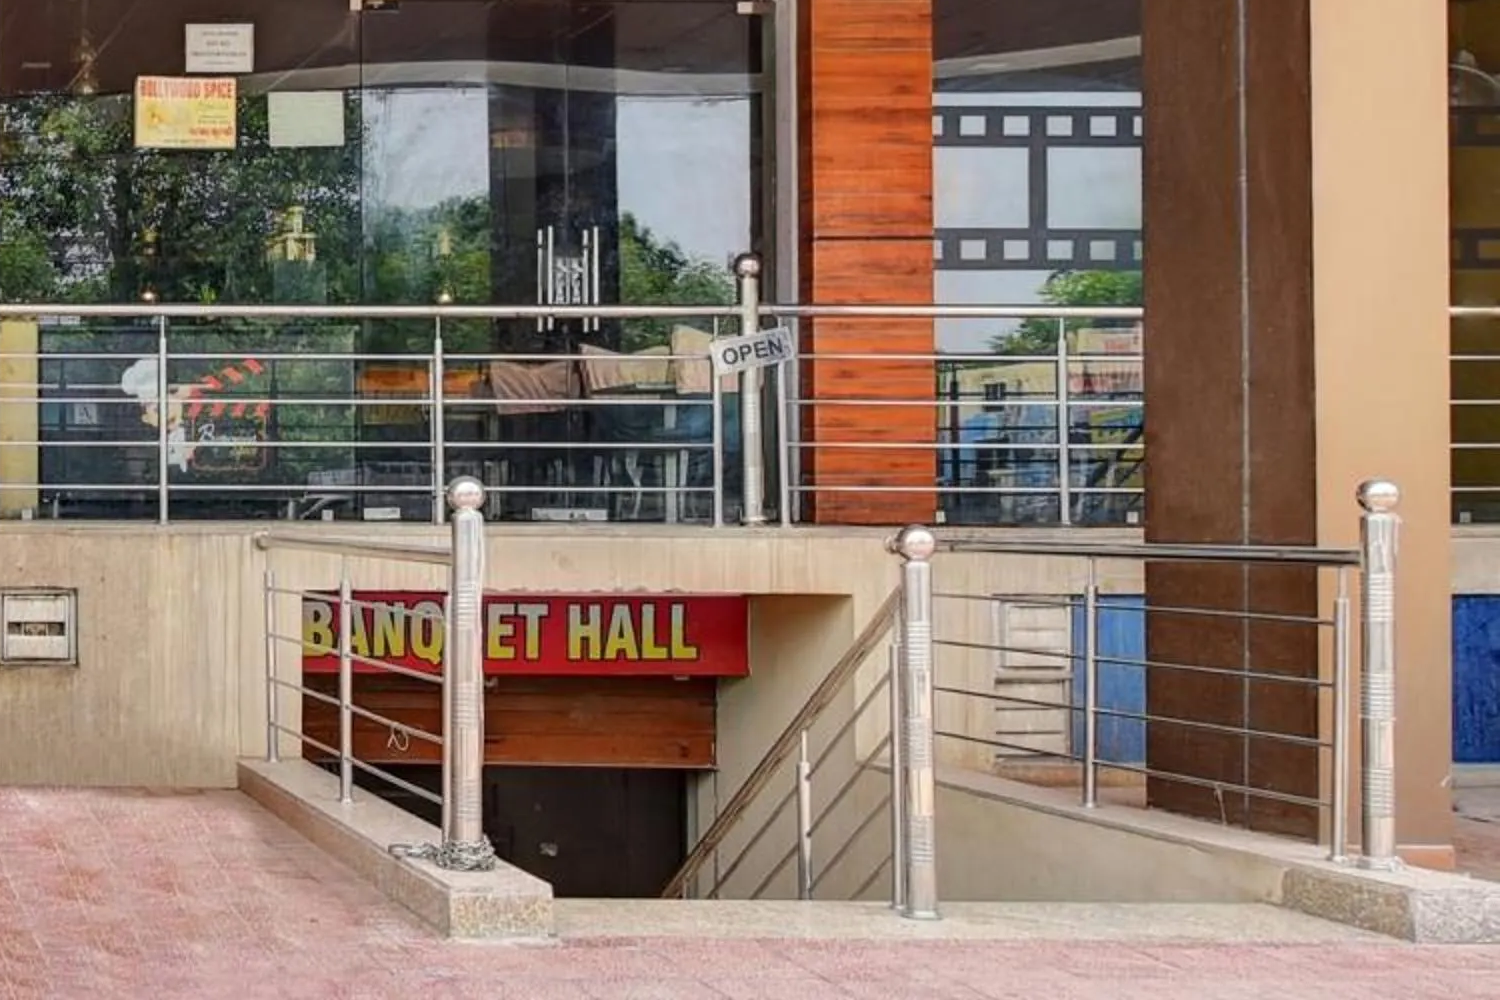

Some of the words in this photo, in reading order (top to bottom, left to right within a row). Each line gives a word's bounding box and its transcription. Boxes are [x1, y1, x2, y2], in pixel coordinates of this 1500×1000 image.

[203, 82, 232, 99] SPICE
[722, 338, 783, 365] OPEN
[301, 600, 549, 664] BANQET
[568, 603, 698, 660] HALL
